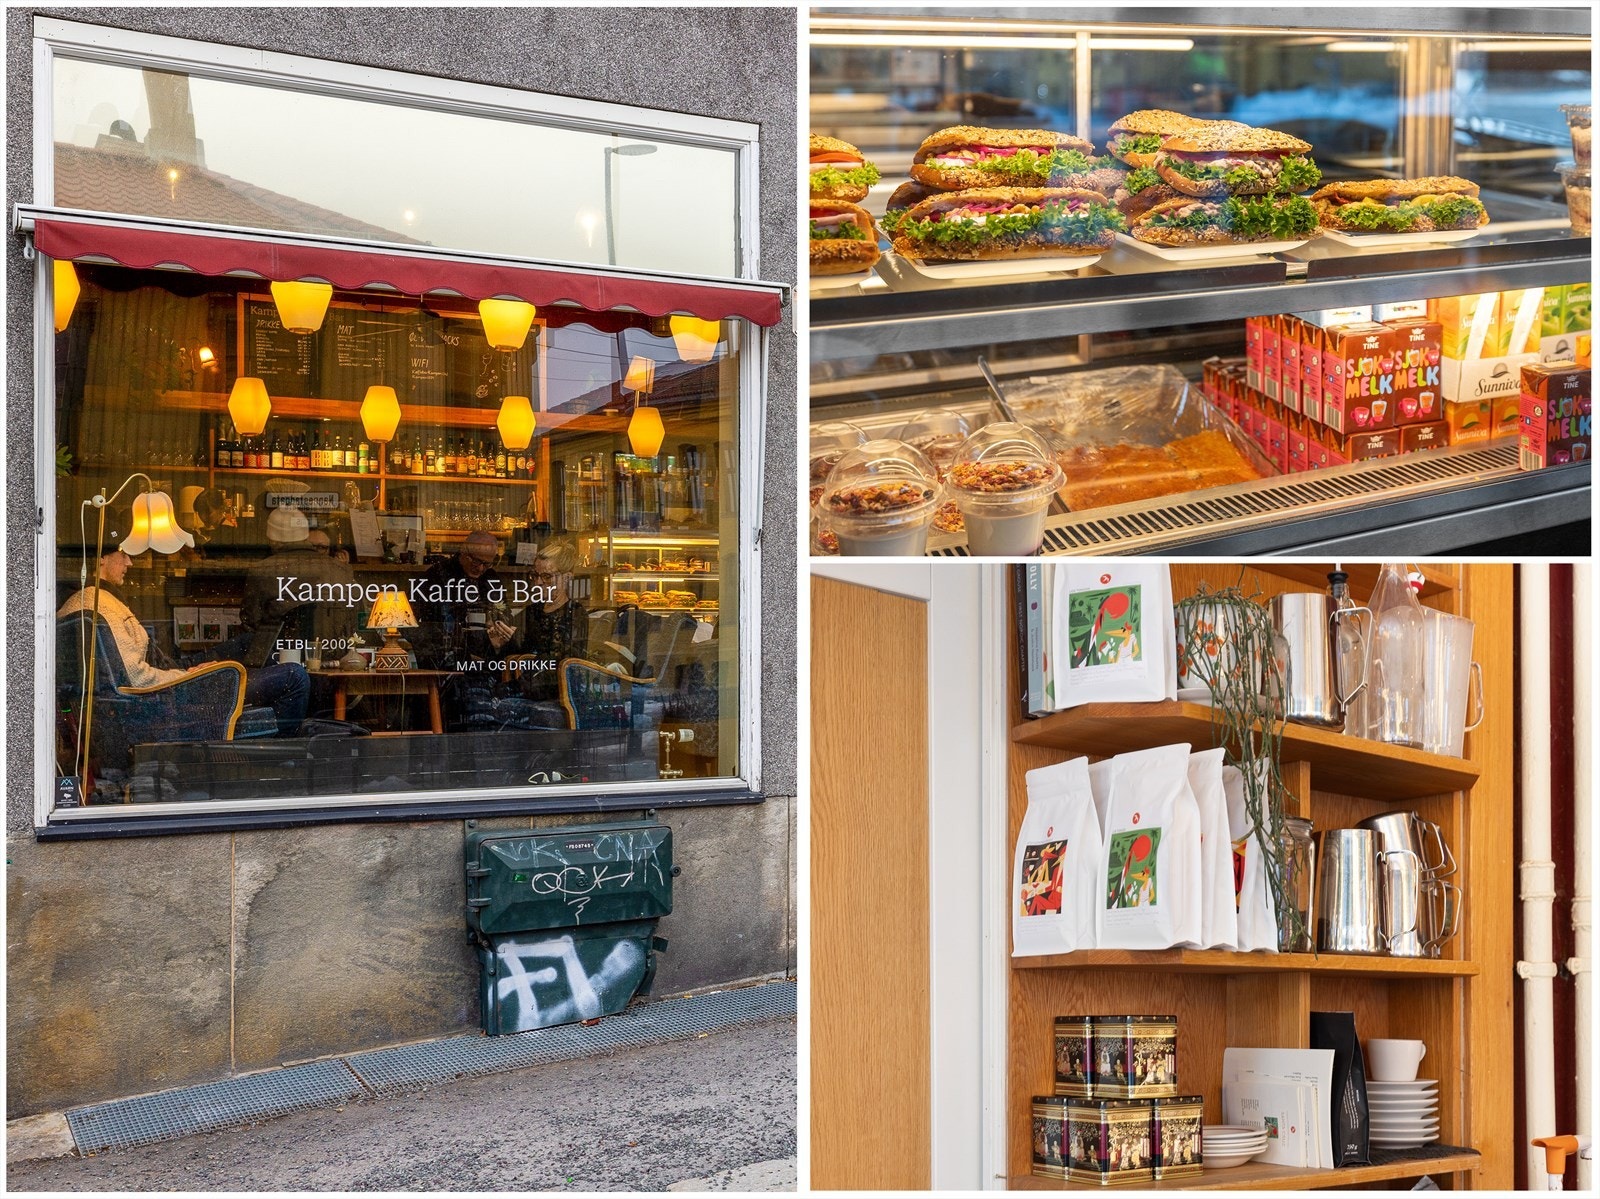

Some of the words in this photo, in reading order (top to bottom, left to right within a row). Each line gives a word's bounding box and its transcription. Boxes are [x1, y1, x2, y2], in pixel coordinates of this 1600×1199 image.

[336, 324, 355, 336] MAT
[1409, 334, 1425, 342] TINE
[1363, 342, 1380, 350] TINE
[411, 358, 429, 368] WIFI
[1394, 366, 1440, 391] MELK
[1563, 381, 1579, 389] TINE
[1345, 374, 1394, 399] MELK
[1455, 428, 1487, 442] Sunniva
[1547, 415, 1591, 442] MELK
[1417, 432, 1434, 441] TINE
[1367, 441, 1384, 449] TINE
[1030, 563, 1038, 591] OLLY
[276, 577, 399, 608] Kampen
[408, 578, 479, 604] Kaffe
[487, 581, 507, 604] &
[513, 580, 557, 604] Bar
[276, 639, 317, 651] ETBL.
[321, 638, 356, 650] 2002
[456, 660, 484, 672] MAT
[488, 660, 507, 671] OG
[509, 659, 557, 671] DRIKKE
